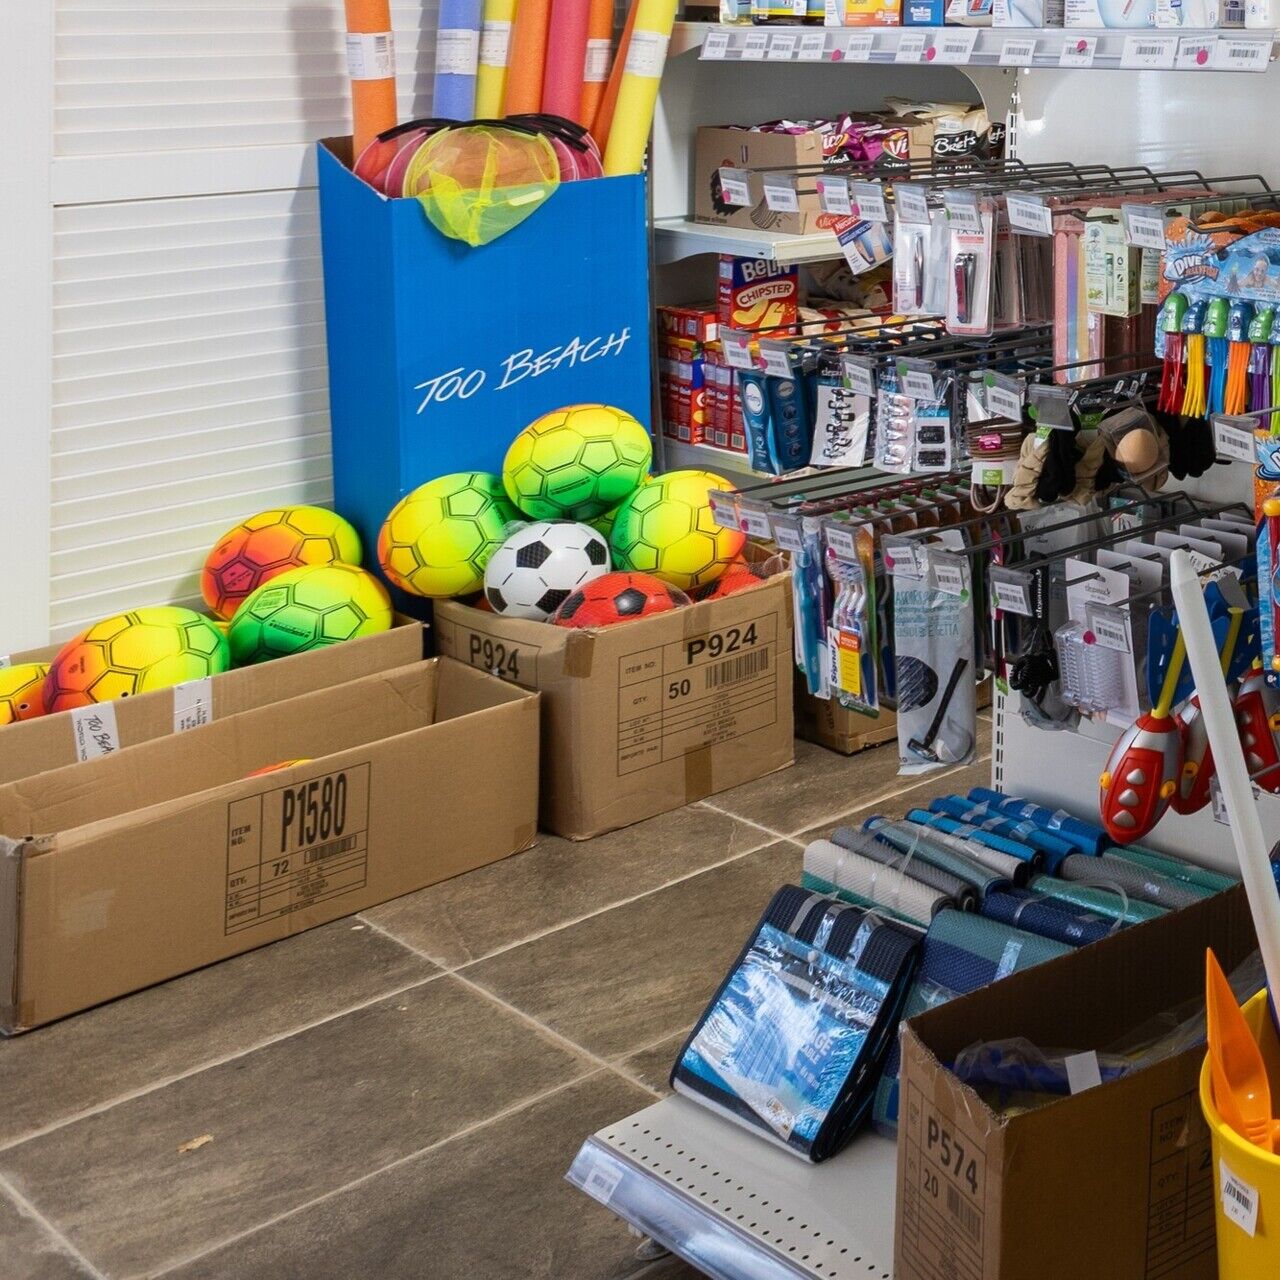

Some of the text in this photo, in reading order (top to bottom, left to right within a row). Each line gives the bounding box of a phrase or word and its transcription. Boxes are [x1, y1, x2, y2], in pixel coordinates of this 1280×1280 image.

[934, 134, 977, 153] Brets
[1173, 254, 1202, 276] DIVE
[740, 283, 792, 305] CHIPSTER
[414, 327, 631, 415] TOO BEACH
[469, 633, 520, 680] P924
[686, 623, 758, 665] P924
[668, 678, 691, 700] 50
[280, 772, 348, 853] P1580
[231, 824, 251, 838] ITEM
[272, 859, 289, 877] 72
[927, 1115, 979, 1195] P574
[923, 1167, 939, 1198] 20
